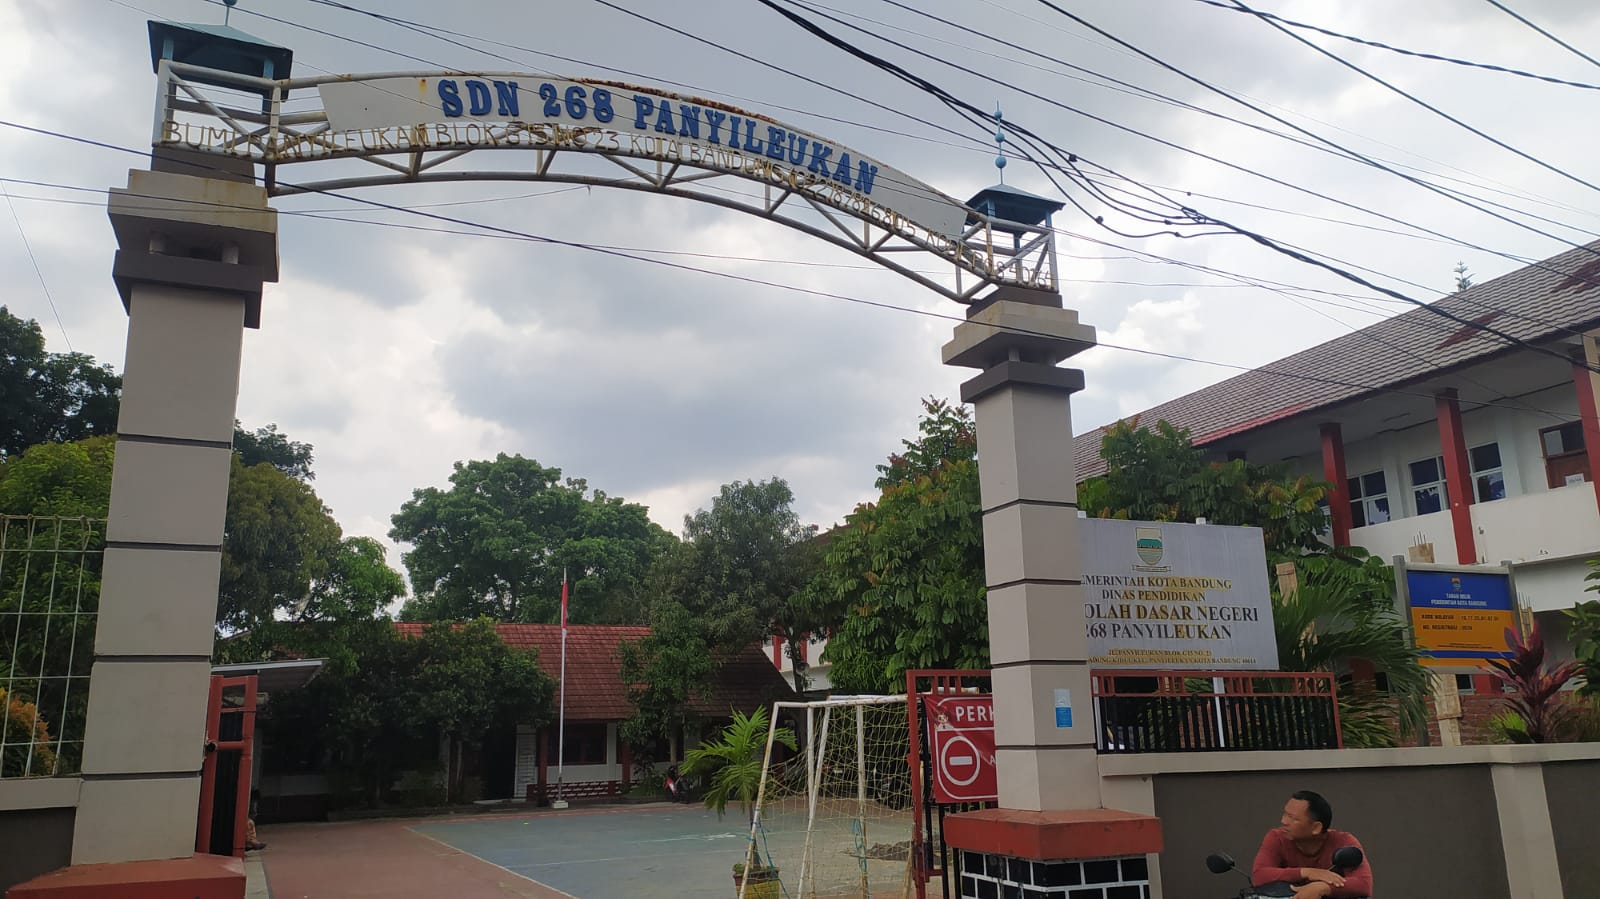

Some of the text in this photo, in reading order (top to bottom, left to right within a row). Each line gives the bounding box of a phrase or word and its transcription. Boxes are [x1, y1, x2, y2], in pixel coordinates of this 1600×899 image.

[162, 119, 237, 155] BUMI
[437, 122, 499, 146] BLOK
[630, 136, 681, 162] KOTA
[438, 79, 879, 195] SDN 268 PANYILEUKAN
[1148, 576, 1178, 588] KOTA
[1180, 578, 1232, 589] BANDUNG
[1102, 589, 1206, 602] DINAS PENDIDIKAN
[1136, 604, 1194, 620] DASAR
[1197, 606, 1259, 622] NEGERI
[1111, 623, 1232, 640] PANYILEUKAN
